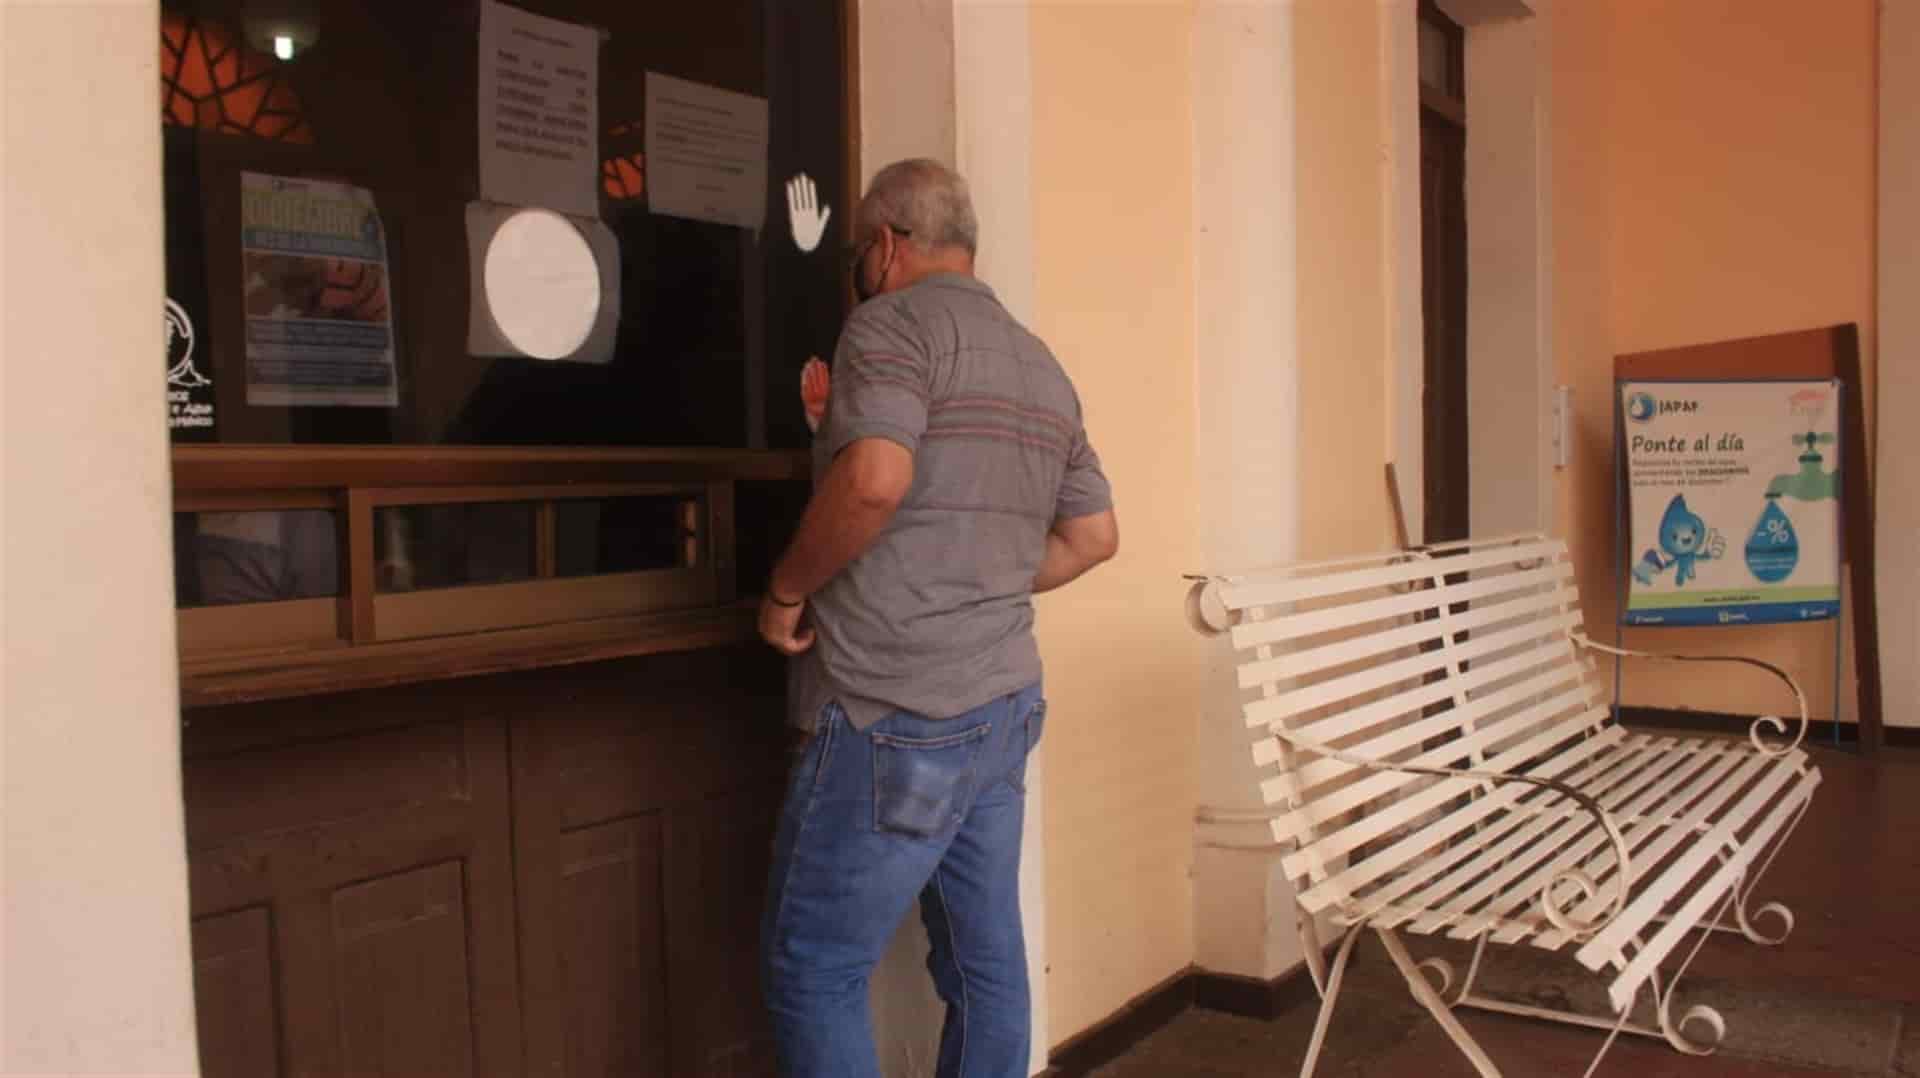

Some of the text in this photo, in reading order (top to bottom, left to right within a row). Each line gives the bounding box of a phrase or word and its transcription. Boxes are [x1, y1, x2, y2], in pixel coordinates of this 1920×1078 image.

[1632, 431, 1745, 453] Ponte al día
